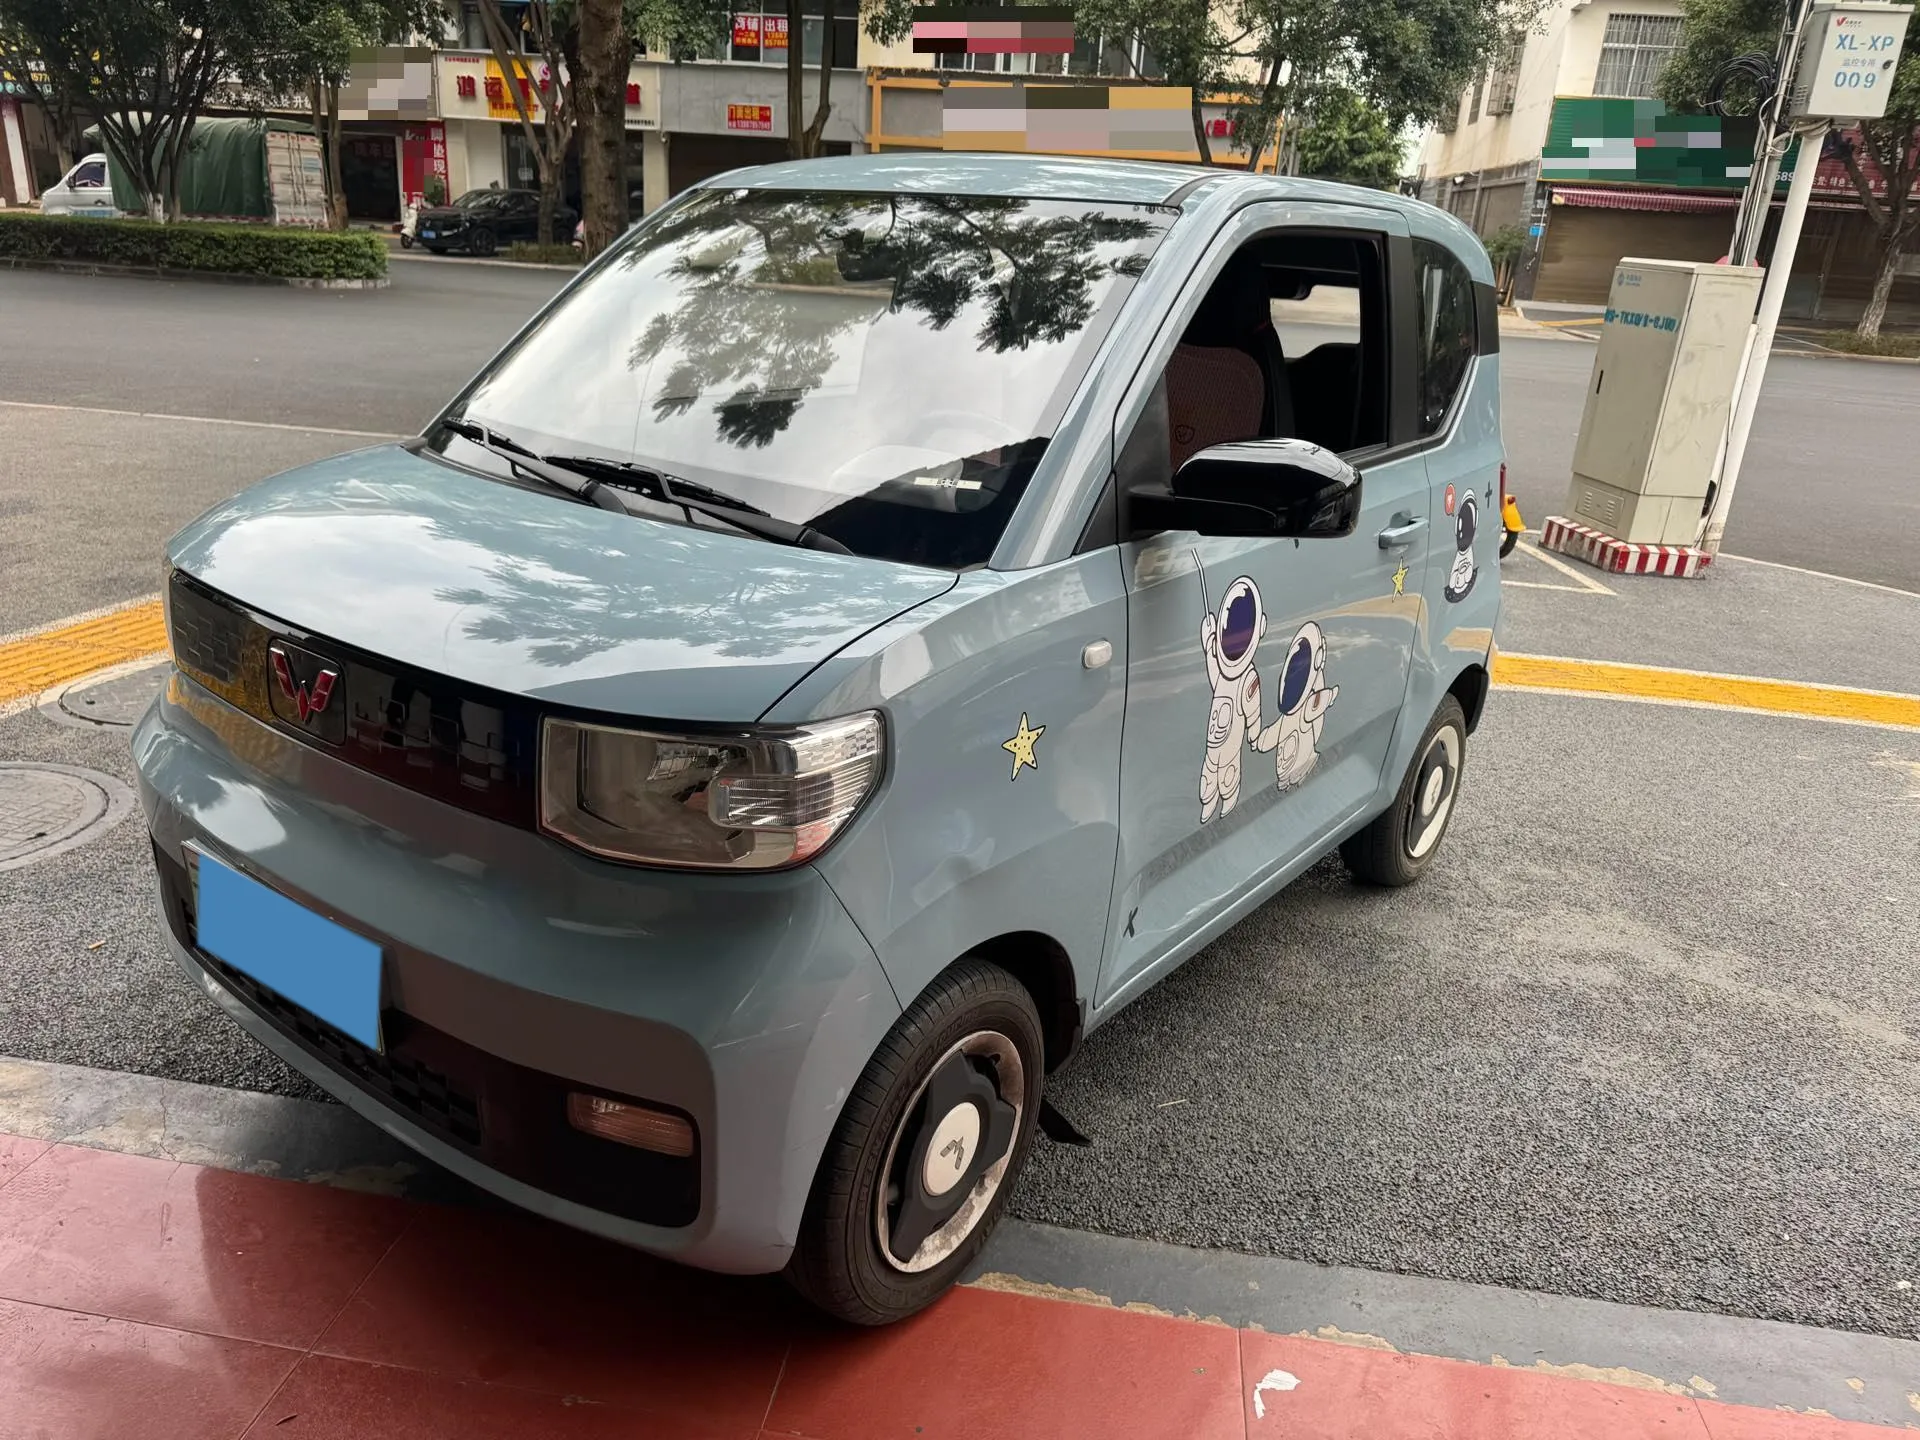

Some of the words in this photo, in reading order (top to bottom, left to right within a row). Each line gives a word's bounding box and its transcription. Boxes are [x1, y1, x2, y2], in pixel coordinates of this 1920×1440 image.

[765, 19, 788, 32] 出租
[1835, 34, 1895, 51] XL-XP
[1842, 58, 1876, 68] 监控专用
[1834, 71, 1876, 89] 009
